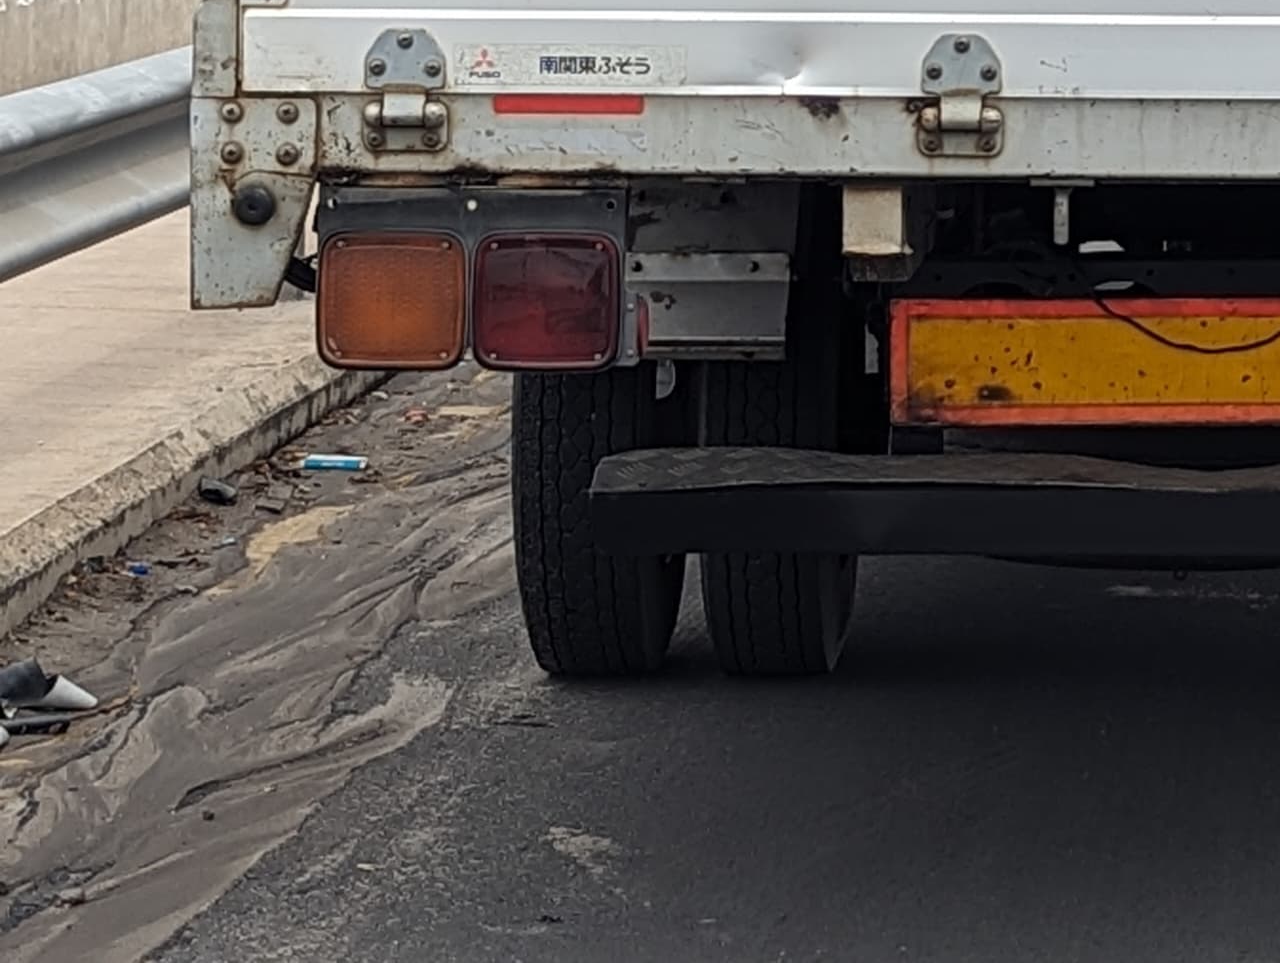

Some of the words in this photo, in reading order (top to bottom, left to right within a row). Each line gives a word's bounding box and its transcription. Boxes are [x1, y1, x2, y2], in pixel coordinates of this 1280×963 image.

[539, 56, 651, 75] 南関東ふそう
[469, 70, 501, 79] FUSO
